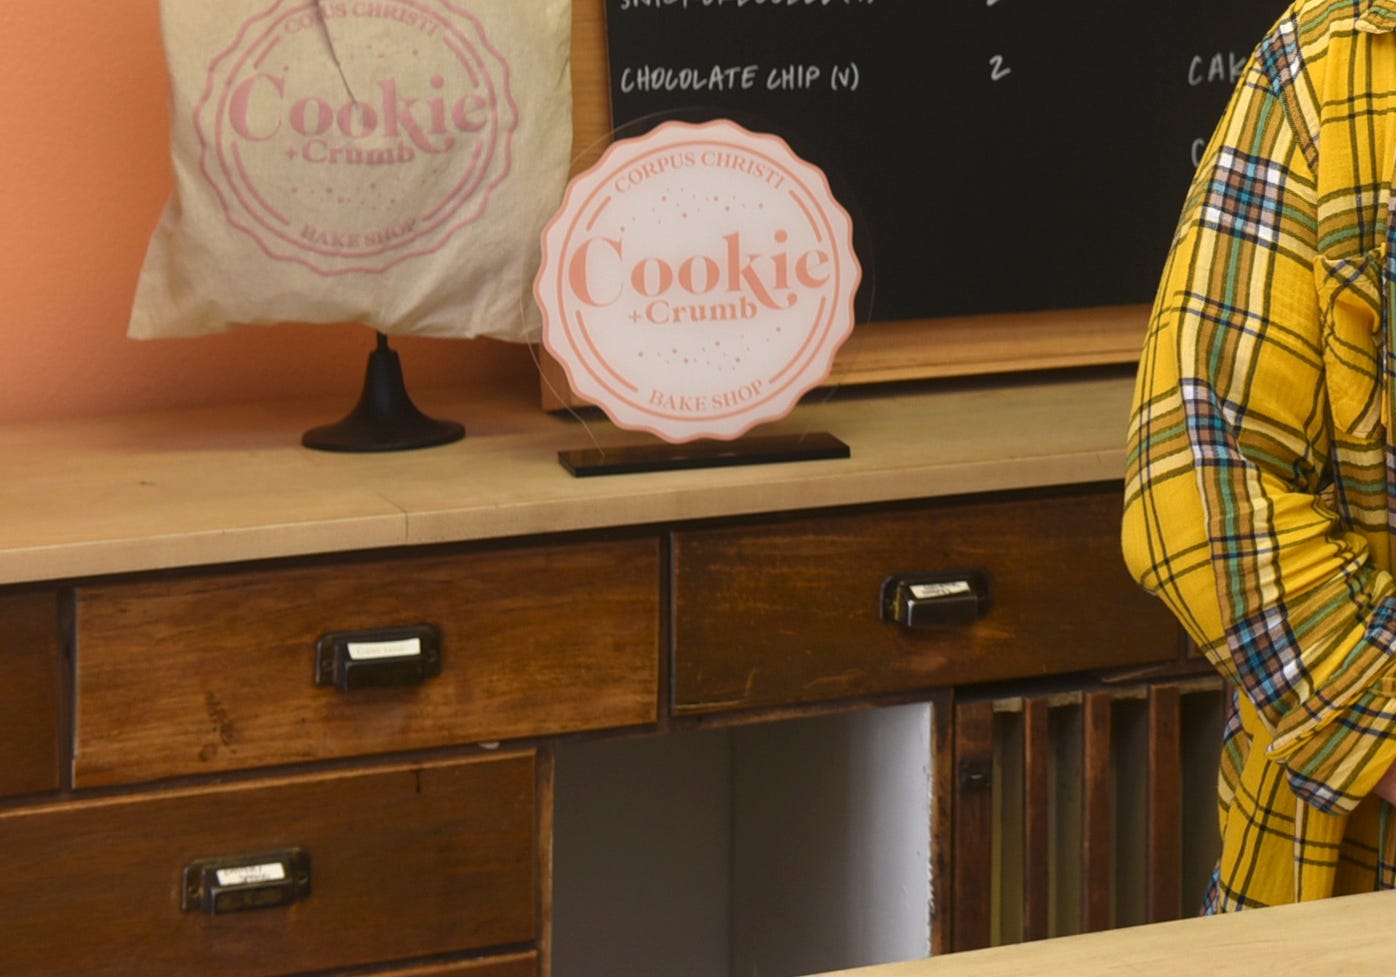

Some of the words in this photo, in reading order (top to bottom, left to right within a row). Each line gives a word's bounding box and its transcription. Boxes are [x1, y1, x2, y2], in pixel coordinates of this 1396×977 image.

[621, 65, 757, 92] CHOCOLATE
[767, 65, 820, 90] CHIP
[831, 63, 859, 90] (V)
[990, 55, 1010, 80] 2
[229, 74, 488, 155] Cookie
[614, 150, 697, 194] CORPUS
[700, 150, 786, 190] CHRISTI
[568, 229, 831, 311] Cookie
[648, 388, 708, 412] BAKE
[711, 379, 764, 409] SHOP
